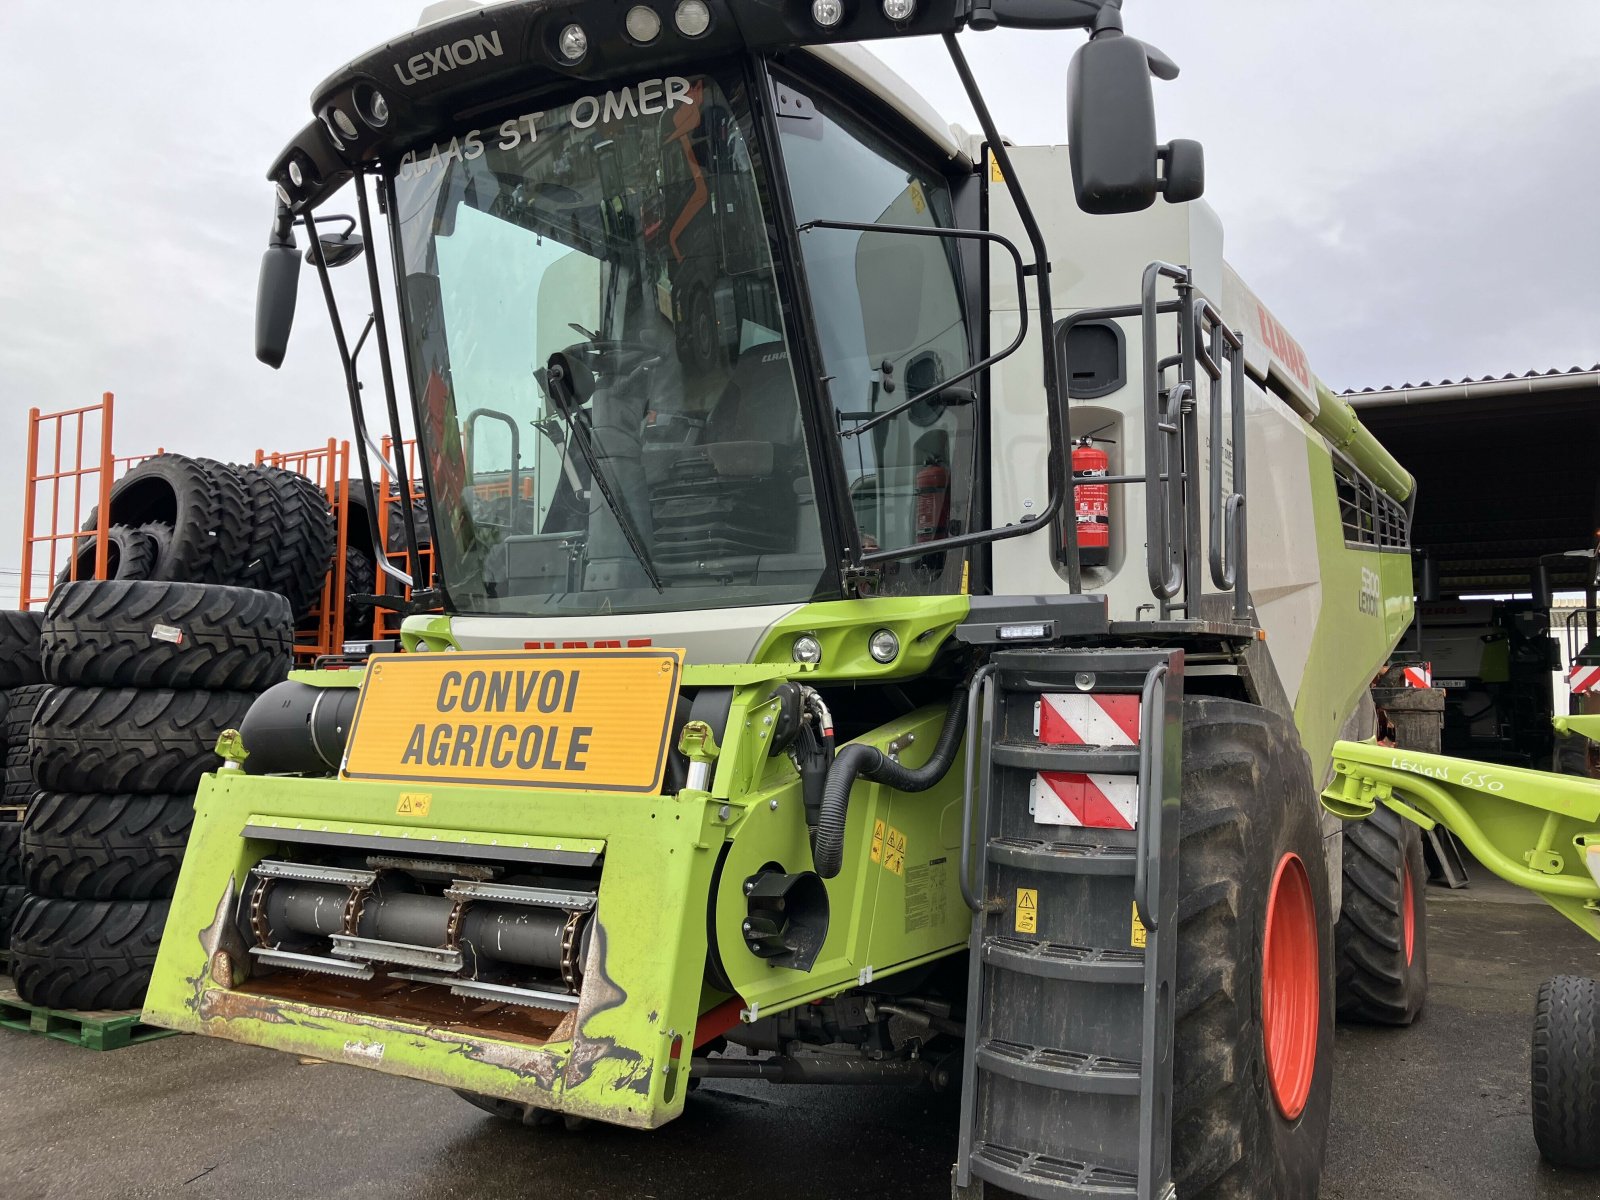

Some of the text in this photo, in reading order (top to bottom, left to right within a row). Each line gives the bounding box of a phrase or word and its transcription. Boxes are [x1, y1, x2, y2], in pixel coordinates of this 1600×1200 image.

[393, 30, 504, 86] LEXION
[400, 76, 694, 181] CLAAS ST OMER
[1256, 303, 1310, 389] CLAAS
[436, 669, 580, 714] CONVOI
[400, 723, 593, 771] AGRICOLE
[1461, 771, 1504, 791] 650
